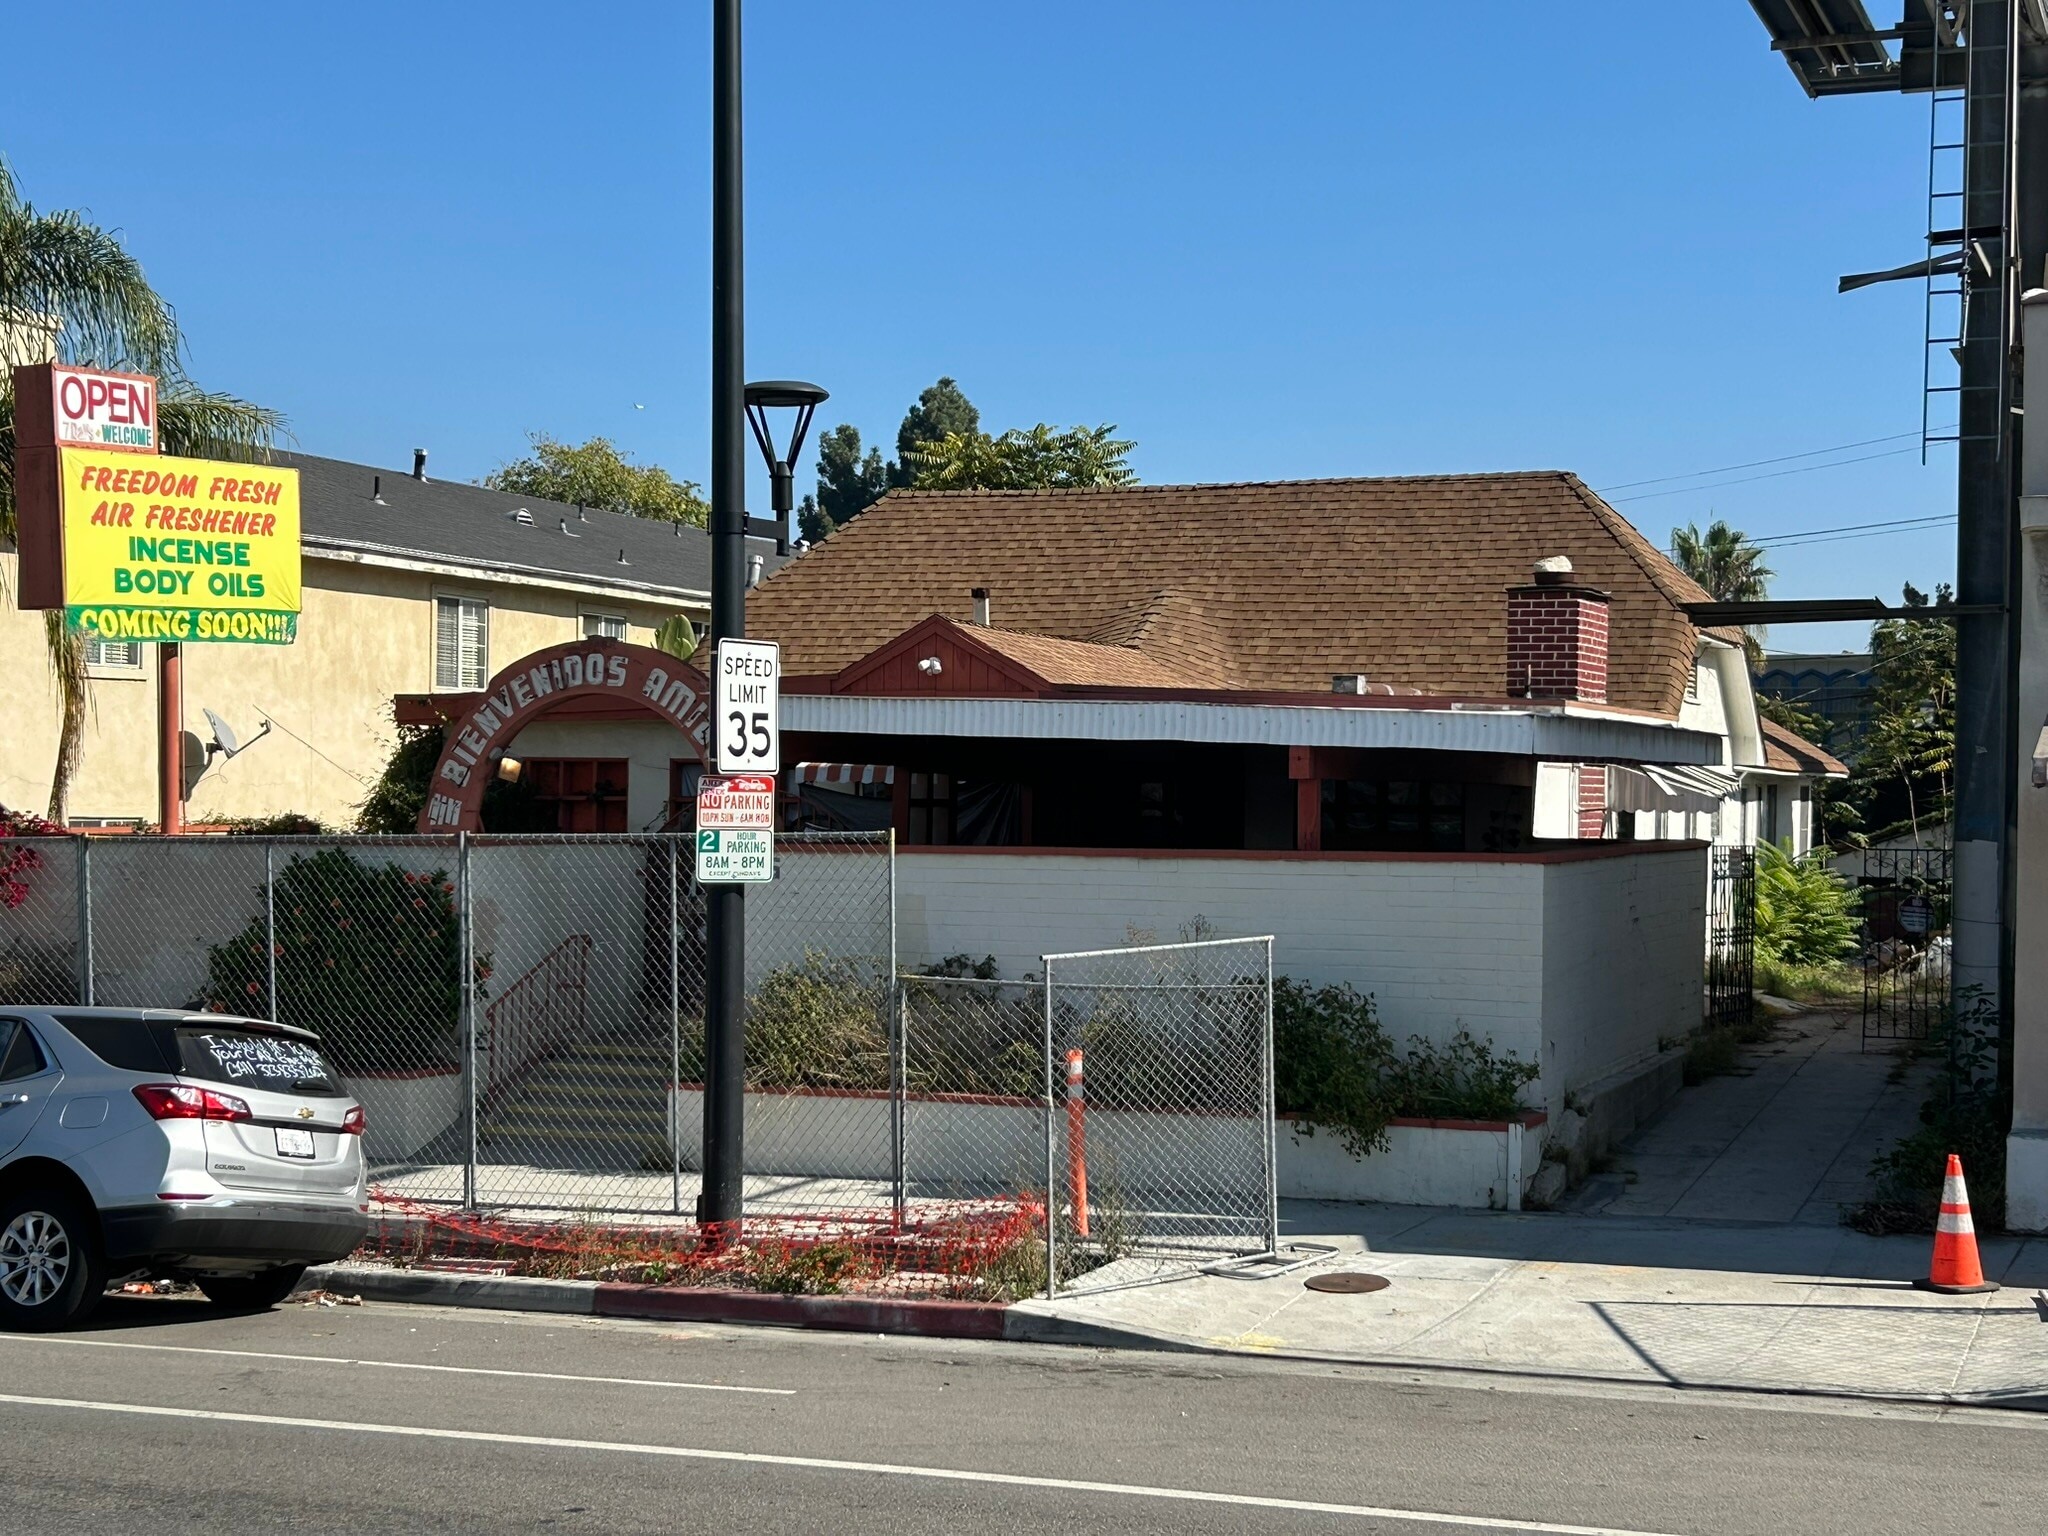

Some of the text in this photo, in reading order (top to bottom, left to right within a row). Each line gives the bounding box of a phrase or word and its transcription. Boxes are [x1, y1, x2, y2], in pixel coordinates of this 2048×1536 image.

[61, 376, 150, 427] OPEN
[102, 424, 152, 446] WELCOME
[81, 466, 282, 506] FREEDOM FRESH
[91, 501, 276, 537] AIR FRESHENER
[129, 536, 250, 567] INCENSE
[114, 568, 265, 598] BODY OILS
[80, 609, 191, 638] COMING
[725, 657, 772, 677] SPEED
[730, 683, 767, 704] LIMIT
[441, 653, 629, 787] BIENVENIDOS
[728, 711, 771, 757] 35
[701, 794, 770, 810] NO PARKING
[702, 830, 757, 849] 2 HOUR
[727, 841, 767, 853] PARKING
[705, 856, 729, 868] 8AM
[741, 856, 764, 868] 8PM
[200, 1035, 223, 1048] I
